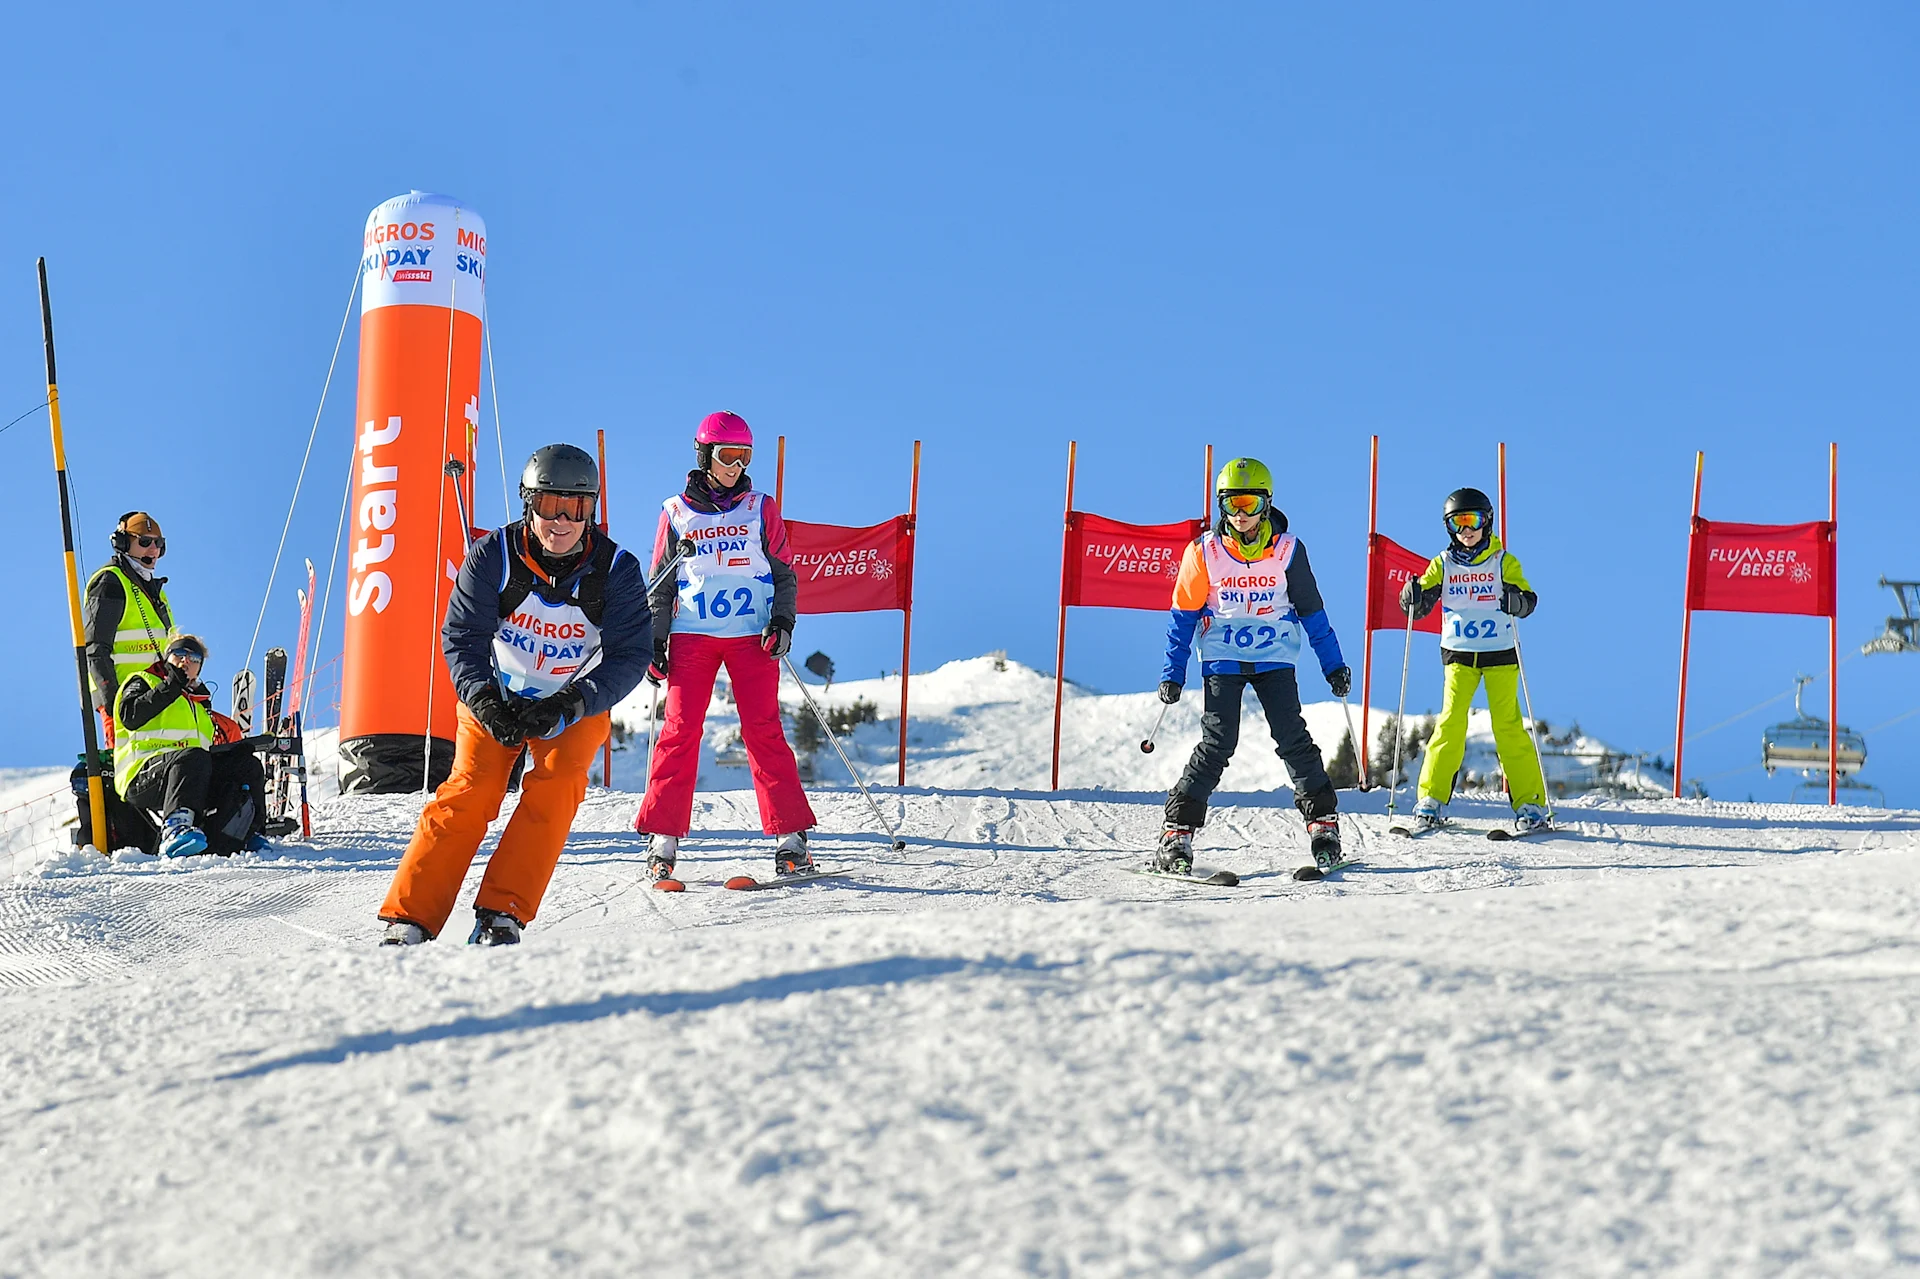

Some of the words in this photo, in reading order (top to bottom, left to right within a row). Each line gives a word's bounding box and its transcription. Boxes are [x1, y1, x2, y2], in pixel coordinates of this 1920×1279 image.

[386, 245, 434, 267] DAY
[456, 251, 482, 279] SKI
[349, 416, 402, 617] Start
[685, 525, 749, 541] MIGROS
[697, 542, 713, 556] KI
[718, 538, 748, 552] DAY
[792, 548, 878, 581] FLUMSER
[1085, 543, 1172, 575] FLUMSER
[1117, 560, 1161, 574] BERG
[1709, 546, 1797, 579] FLUMSER
[824, 562, 867, 577] BERG
[1449, 572, 1495, 584] MIGROS
[1741, 563, 1785, 577] BERG
[1220, 576, 1277, 588] MIGROS
[1448, 585, 1467, 595] SKI
[1472, 584, 1494, 595] DAY
[692, 587, 756, 620] 162
[1220, 590, 1244, 603] SKI
[1249, 590, 1275, 602] DAY
[506, 611, 586, 639] MIGROS
[1453, 619, 1498, 639] 162
[124, 641, 161, 652] swisssi
[500, 627, 536, 654] SKI
[542, 641, 587, 660] DAY
[1222, 624, 1277, 649] 162
